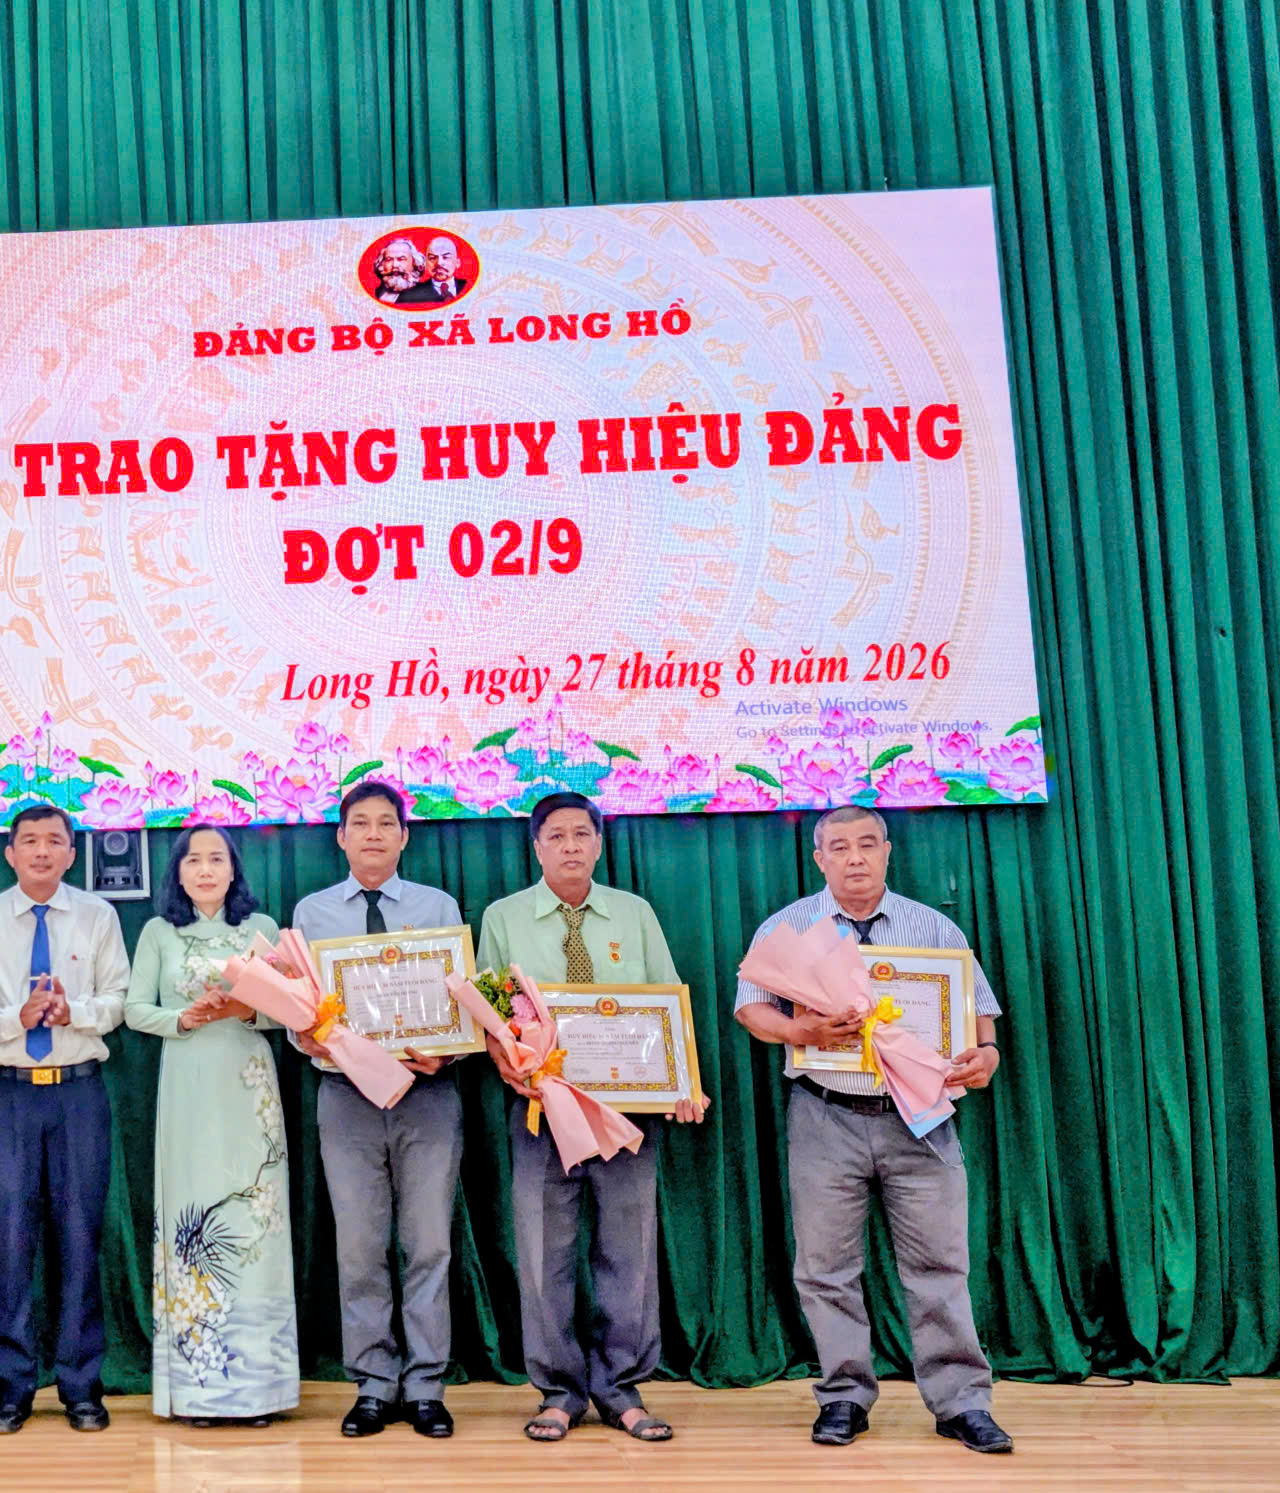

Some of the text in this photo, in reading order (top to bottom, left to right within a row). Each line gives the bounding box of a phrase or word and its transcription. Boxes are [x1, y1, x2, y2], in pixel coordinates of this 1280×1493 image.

[193, 298, 693, 358] ĐẢNG BỘ XÃ LONG HỒ
[14, 437, 195, 498] TRAO
[216, 420, 399, 502] TẶNG
[420, 420, 557, 481] HUY
[577, 401, 743, 484] HIỆU
[765, 390, 964, 467] ĐẢNG
[283, 517, 584, 596] ĐỢT 02/9
[280, 640, 951, 710] Long Hồ, ngày 27 tháng 8 năm 2026
[735, 696, 909, 716] Activate Windows
[736, 726, 757, 739] Go
